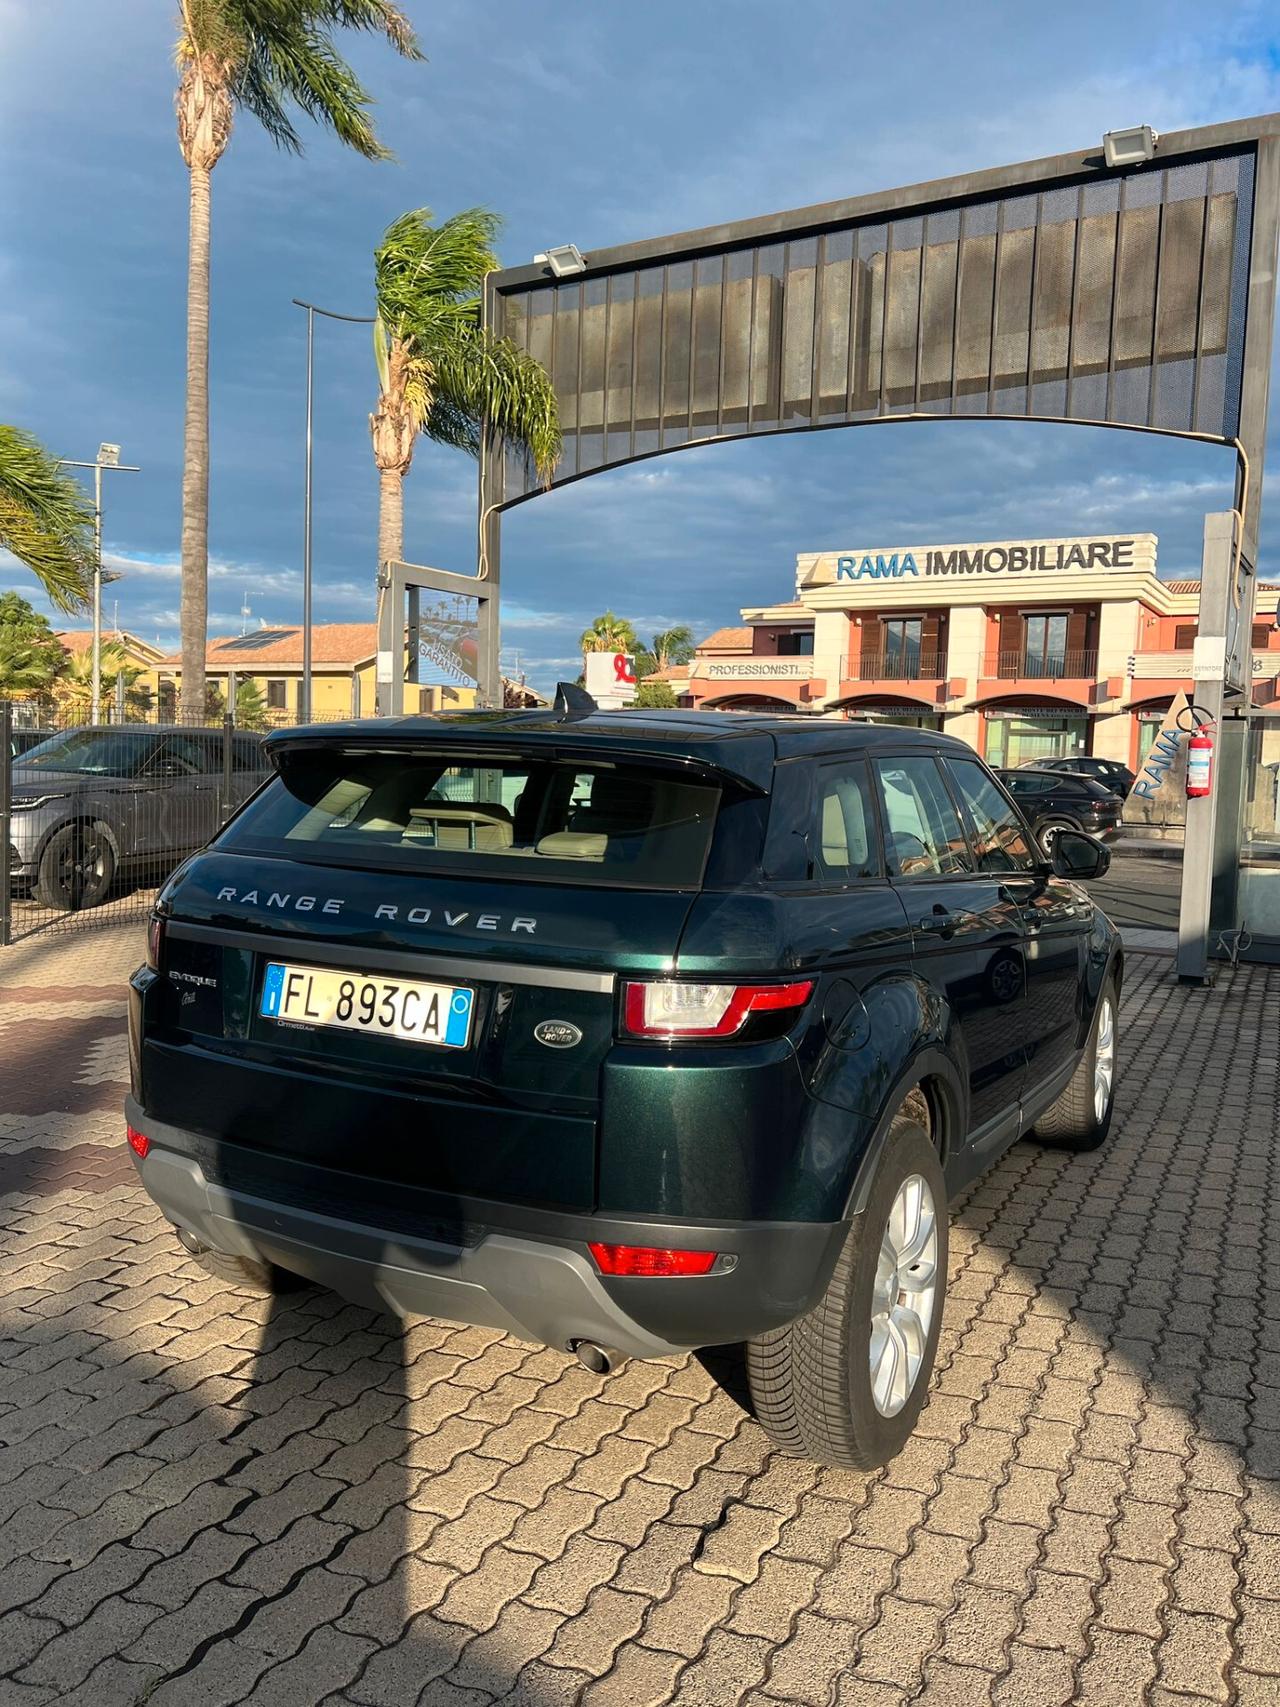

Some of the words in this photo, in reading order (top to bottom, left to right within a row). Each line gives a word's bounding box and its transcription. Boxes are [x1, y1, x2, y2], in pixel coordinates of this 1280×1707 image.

[837, 553, 919, 580] RAMA
[926, 540, 1135, 576] IMMOBILIARE
[1133, 728, 1186, 800] RAMA
[216, 886, 345, 915] RANGE
[374, 904, 538, 934] ROVER
[168, 970, 217, 988] EVOQUE
[284, 973, 320, 1018] FL
[336, 980, 440, 1036] 893CA
